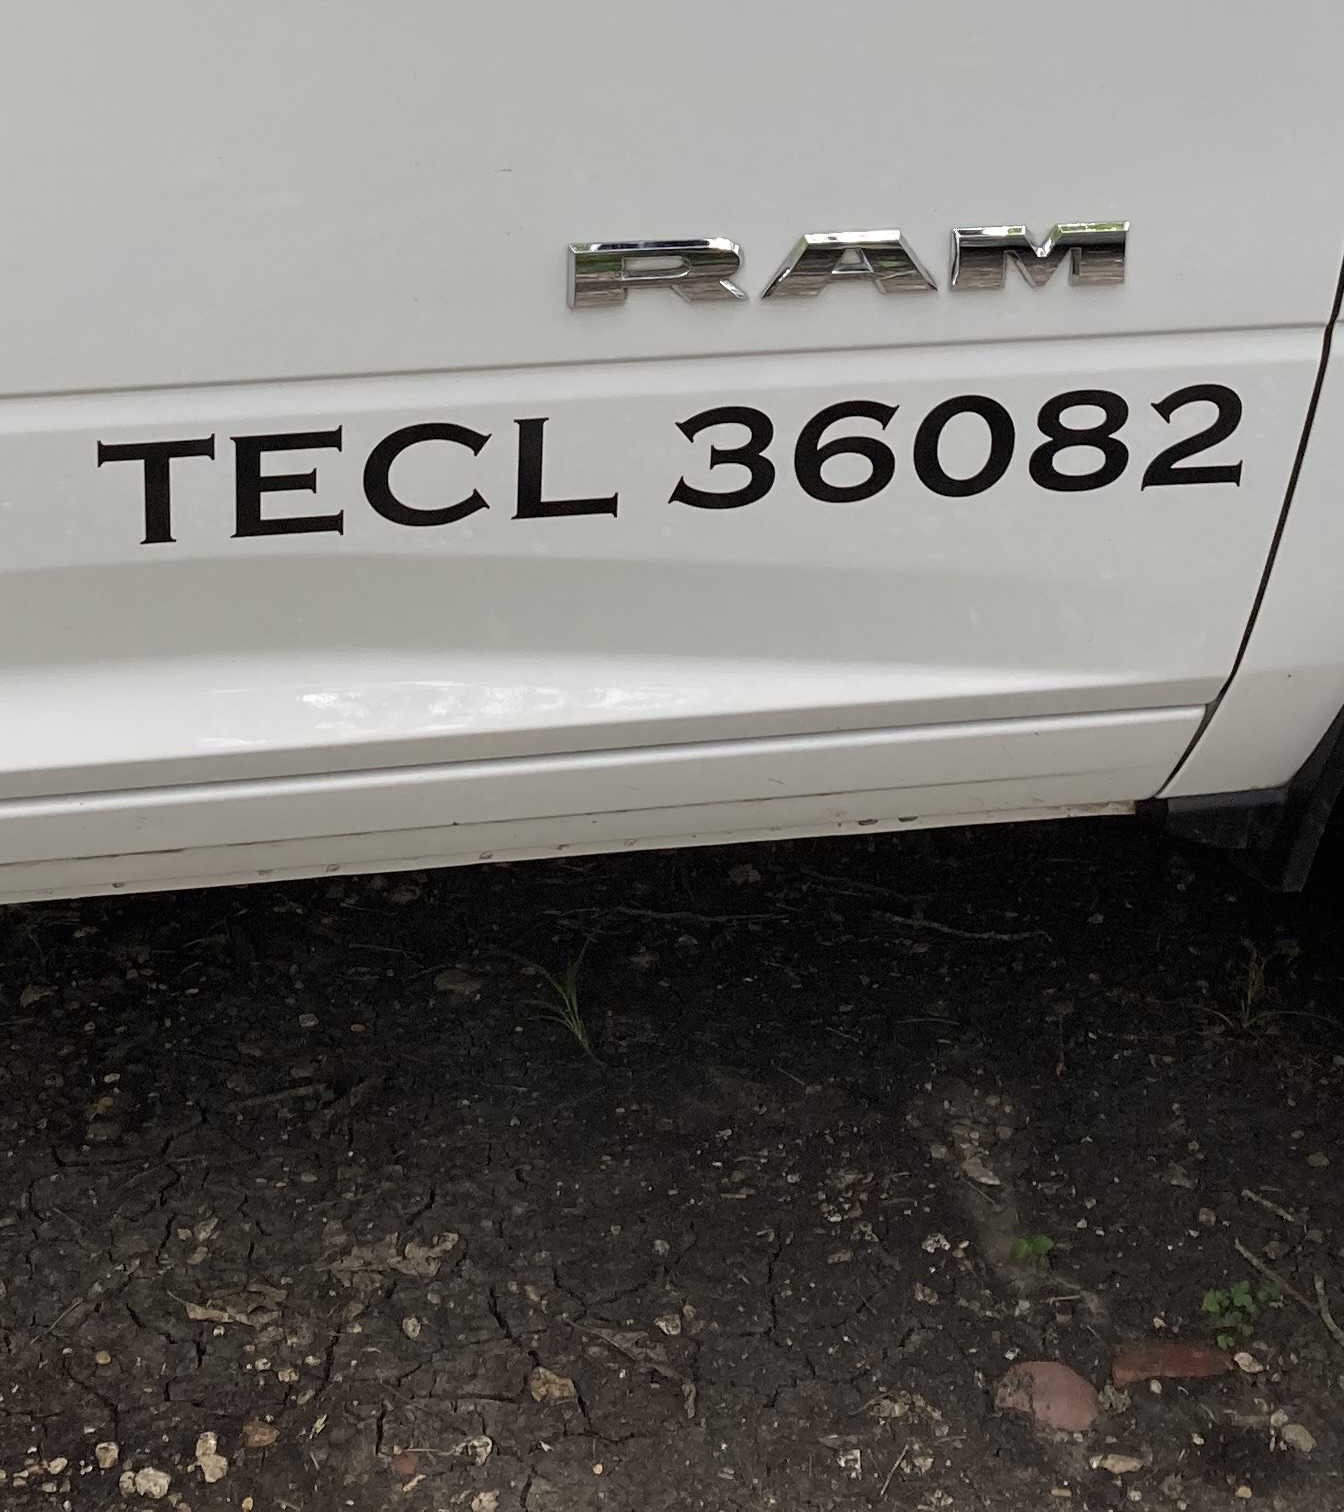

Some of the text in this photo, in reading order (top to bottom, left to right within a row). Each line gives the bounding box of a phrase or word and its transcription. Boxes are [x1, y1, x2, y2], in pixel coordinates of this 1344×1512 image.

[566, 220, 1131, 309] RAM
[96, 384, 1244, 545] TECL 36082
